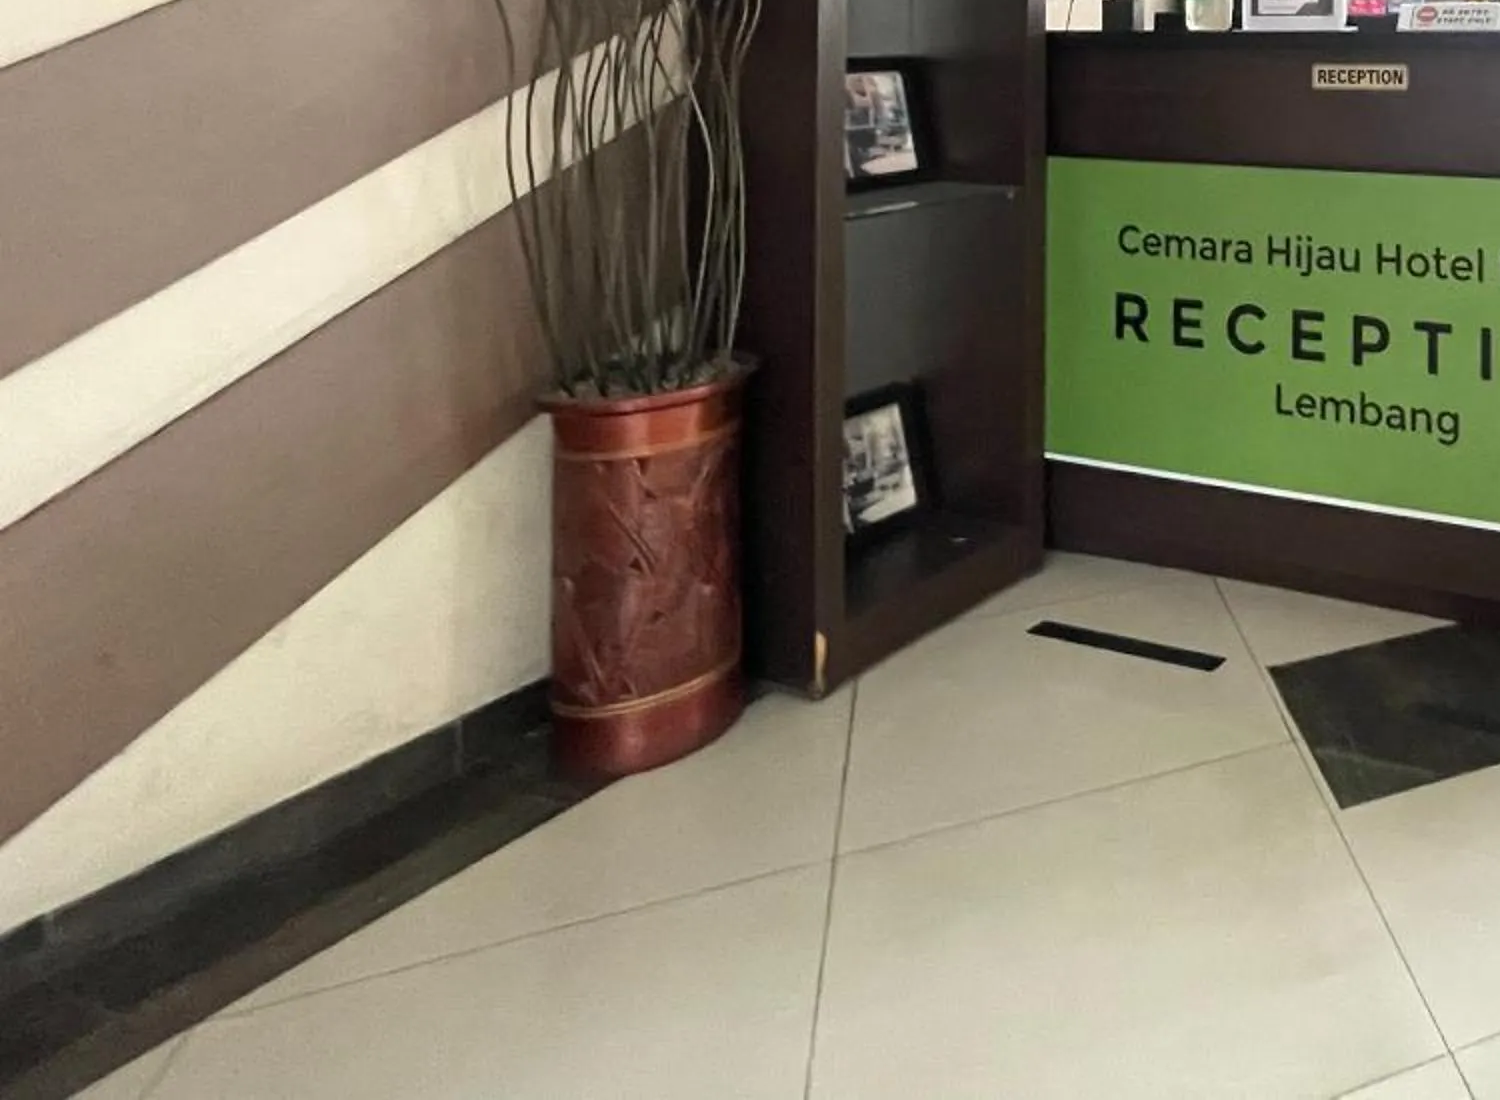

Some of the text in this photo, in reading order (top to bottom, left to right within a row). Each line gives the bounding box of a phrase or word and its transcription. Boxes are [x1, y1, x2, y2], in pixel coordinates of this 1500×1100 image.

[1317, 69, 1403, 85] RECEPTION
[1117, 224, 1254, 265] Cemara
[1267, 234, 1361, 277] Hijau
[1376, 243, 1485, 283] Hotel
[1275, 383, 1460, 447] Lembang
